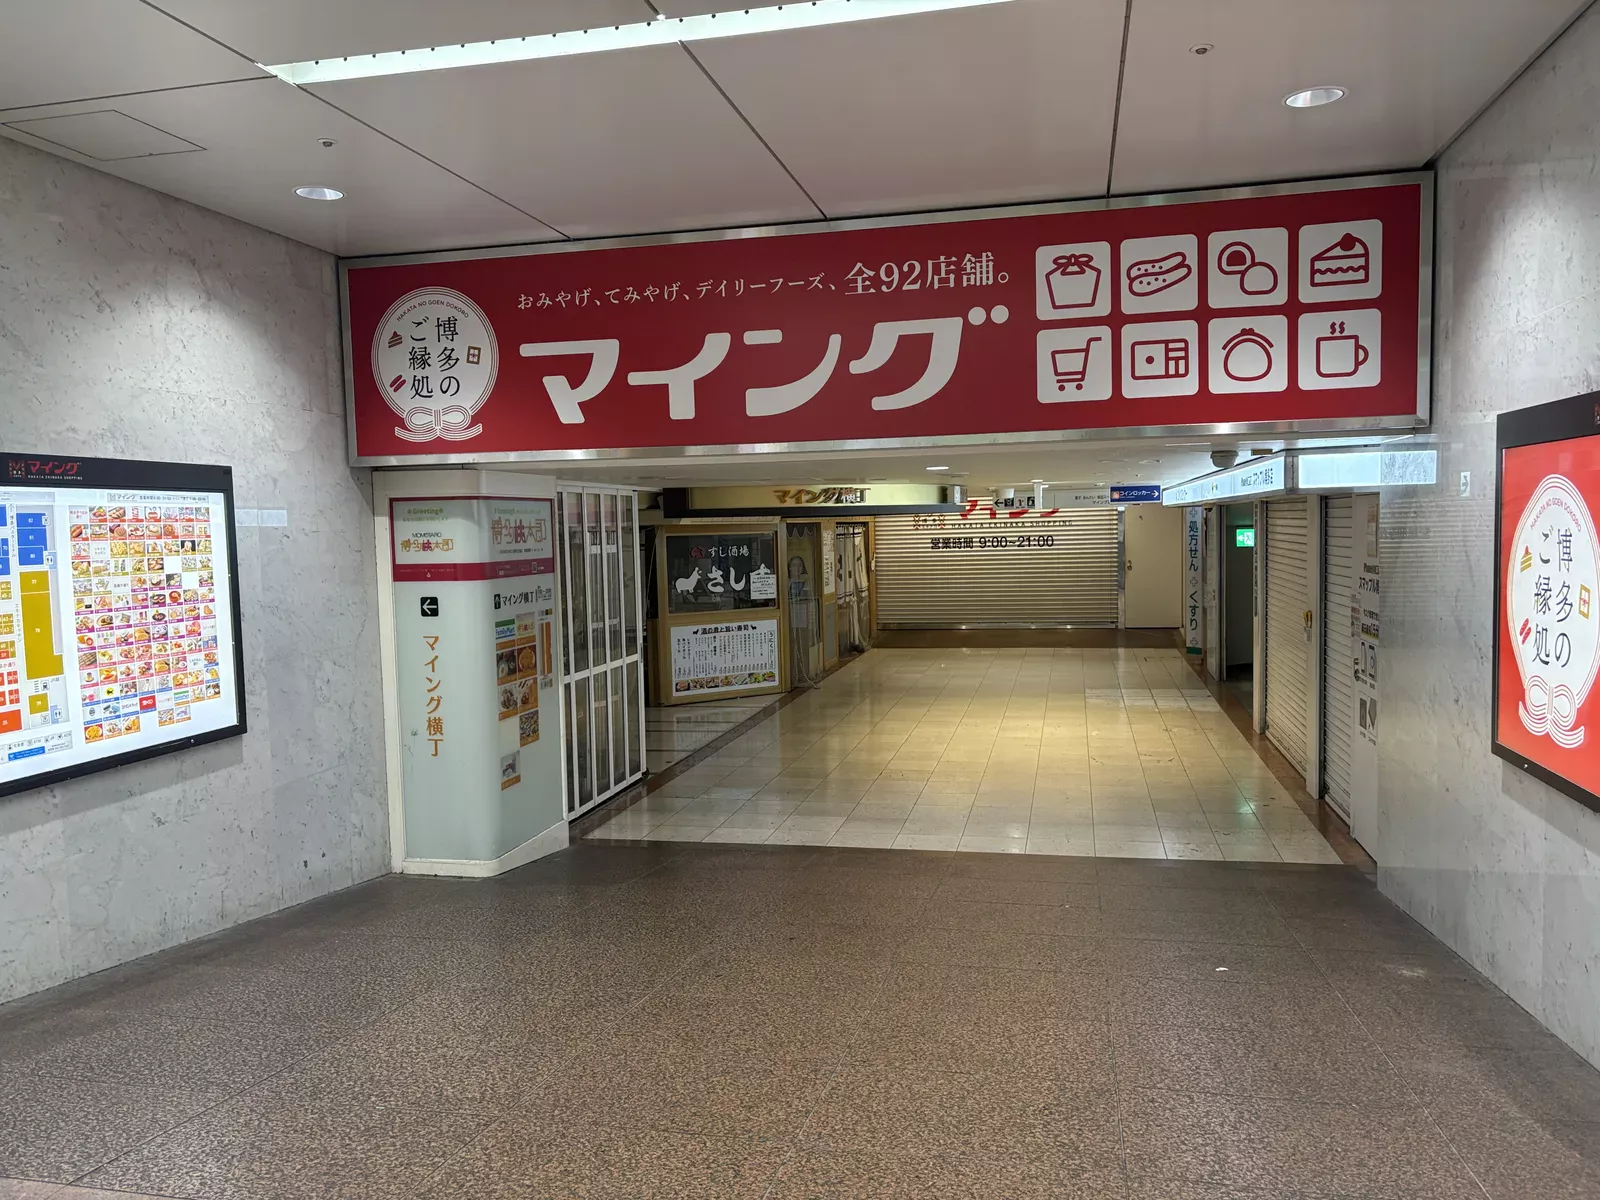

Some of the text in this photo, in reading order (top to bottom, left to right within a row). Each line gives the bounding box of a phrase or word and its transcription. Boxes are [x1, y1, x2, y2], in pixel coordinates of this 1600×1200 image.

[396, 304, 418, 322] HAKATA
[418, 300, 427, 308] NO
[445, 302, 469, 319] DOKORO
[408, 315, 434, 400] ご縁処
[434, 315, 460, 397] 博多の
[518, 304, 1010, 425] マイング
[27, 460, 82, 475] マイング
[773, 486, 872, 504] マイング横丁
[1530, 503, 1546, 530] HAKATA
[1563, 502, 1582, 532] DOKORO
[707, 544, 750, 558] すし酒場
[930, 535, 1055, 550] 営業時間 9:00~21:00
[1188, 520, 1199, 572] 処方せん
[501, 591, 534, 606] マイング横丁
[1188, 590, 1200, 631] くすり
[1532, 525, 1554, 667] ご縁処
[1554, 528, 1574, 668] 博多の
[496, 625, 516, 636] FamilyMart
[422, 635, 444, 757] マイング横丁
